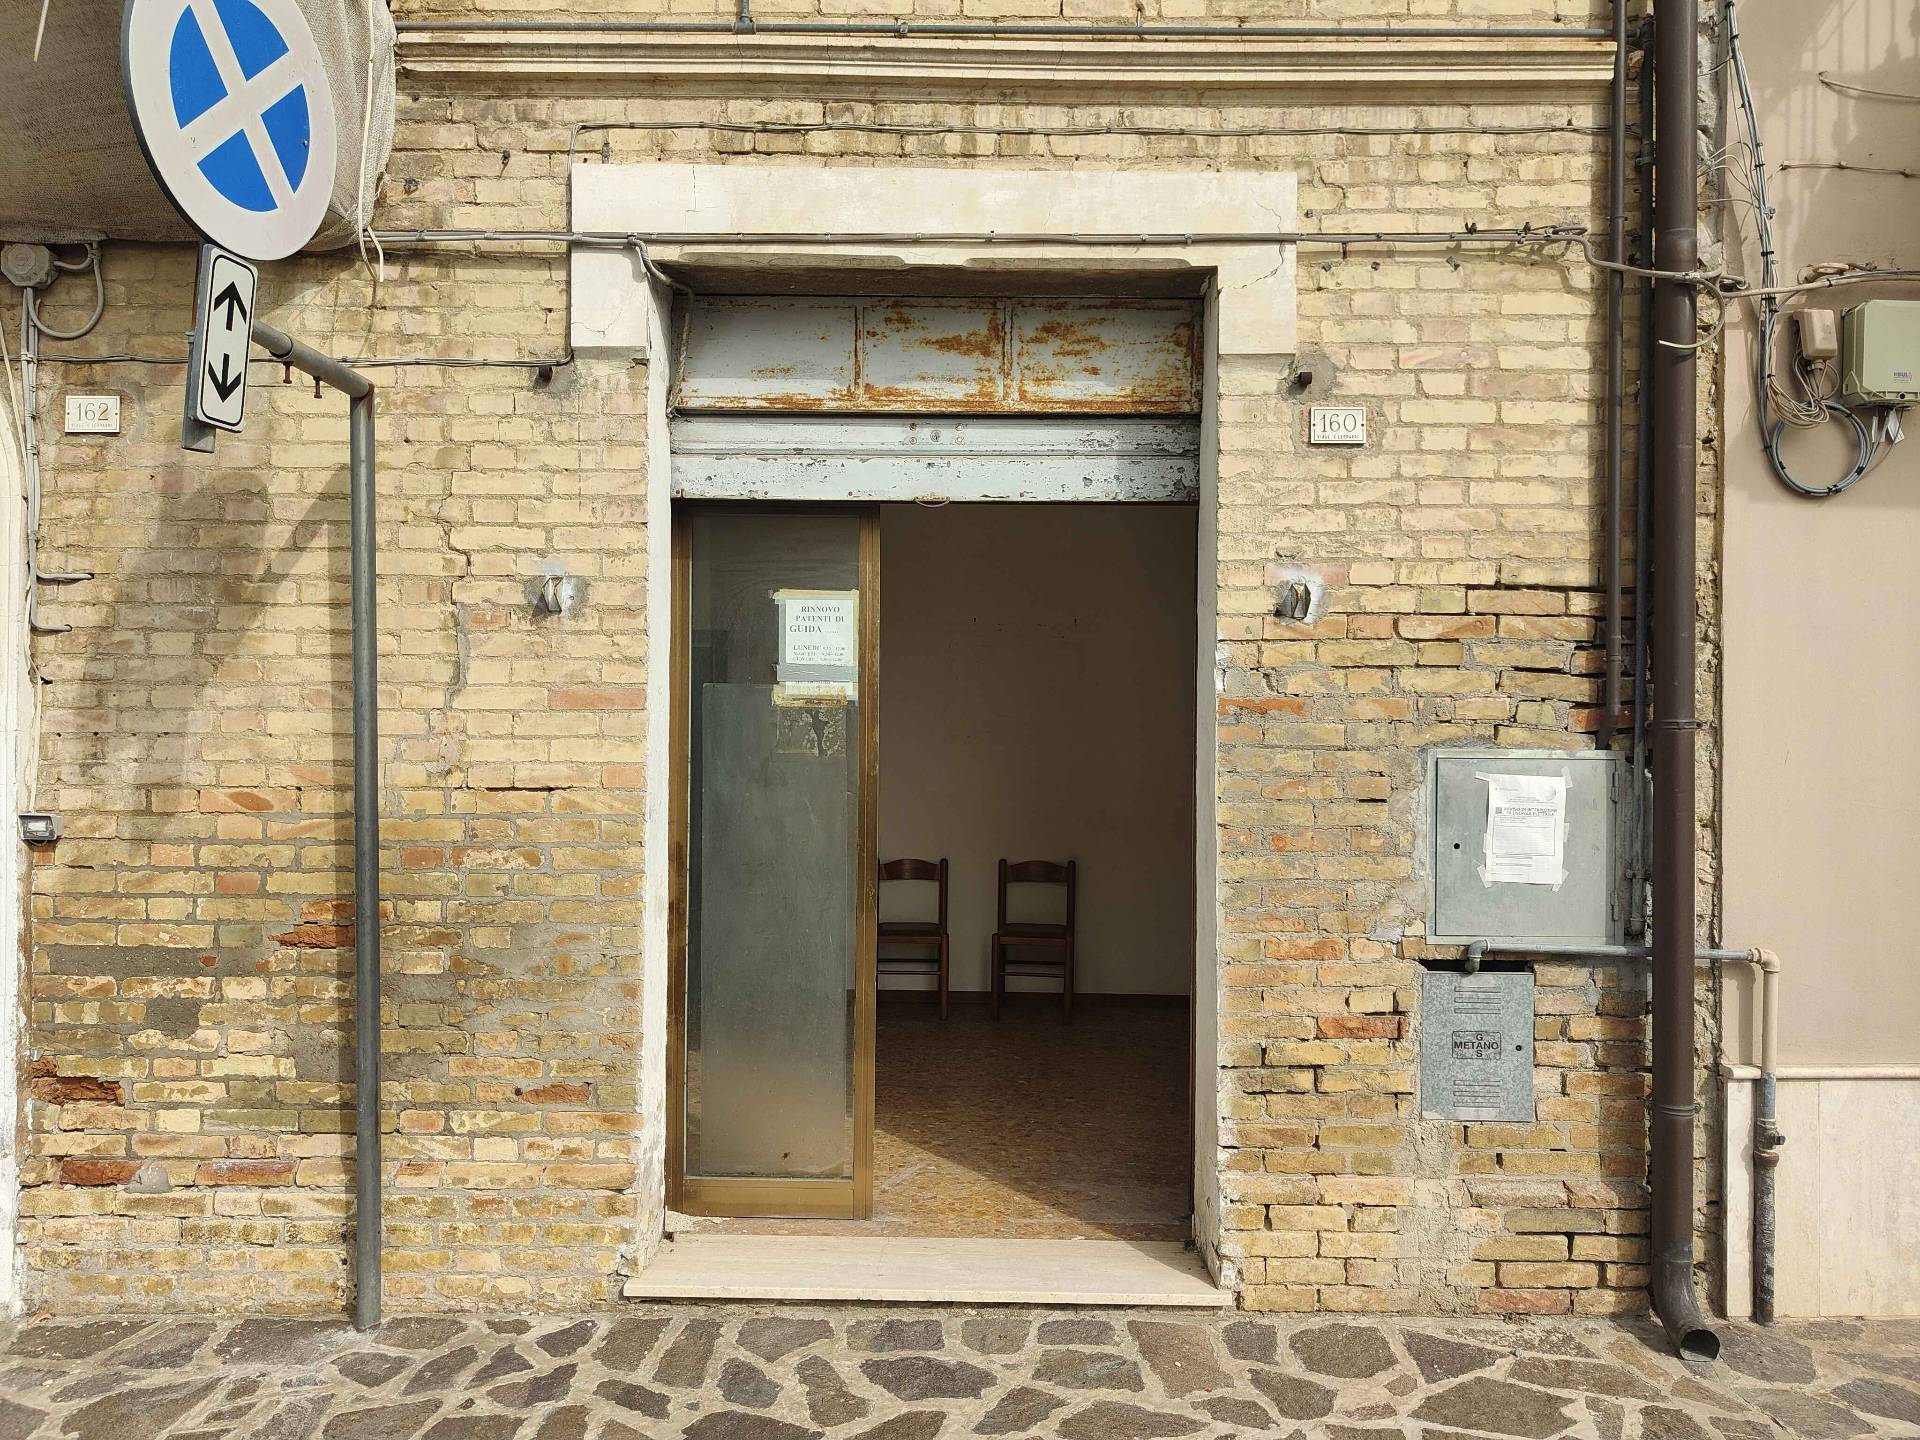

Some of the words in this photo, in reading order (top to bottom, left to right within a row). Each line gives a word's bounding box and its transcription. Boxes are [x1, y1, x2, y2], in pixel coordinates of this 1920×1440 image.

[77, 402, 109, 421] 162
[1320, 413, 1357, 432] 160
[789, 624, 822, 633] GUIDA
[1475, 1033, 1483, 1041] G
[1454, 1041, 1499, 1050] METANO
[1476, 1049, 1483, 1058] S
